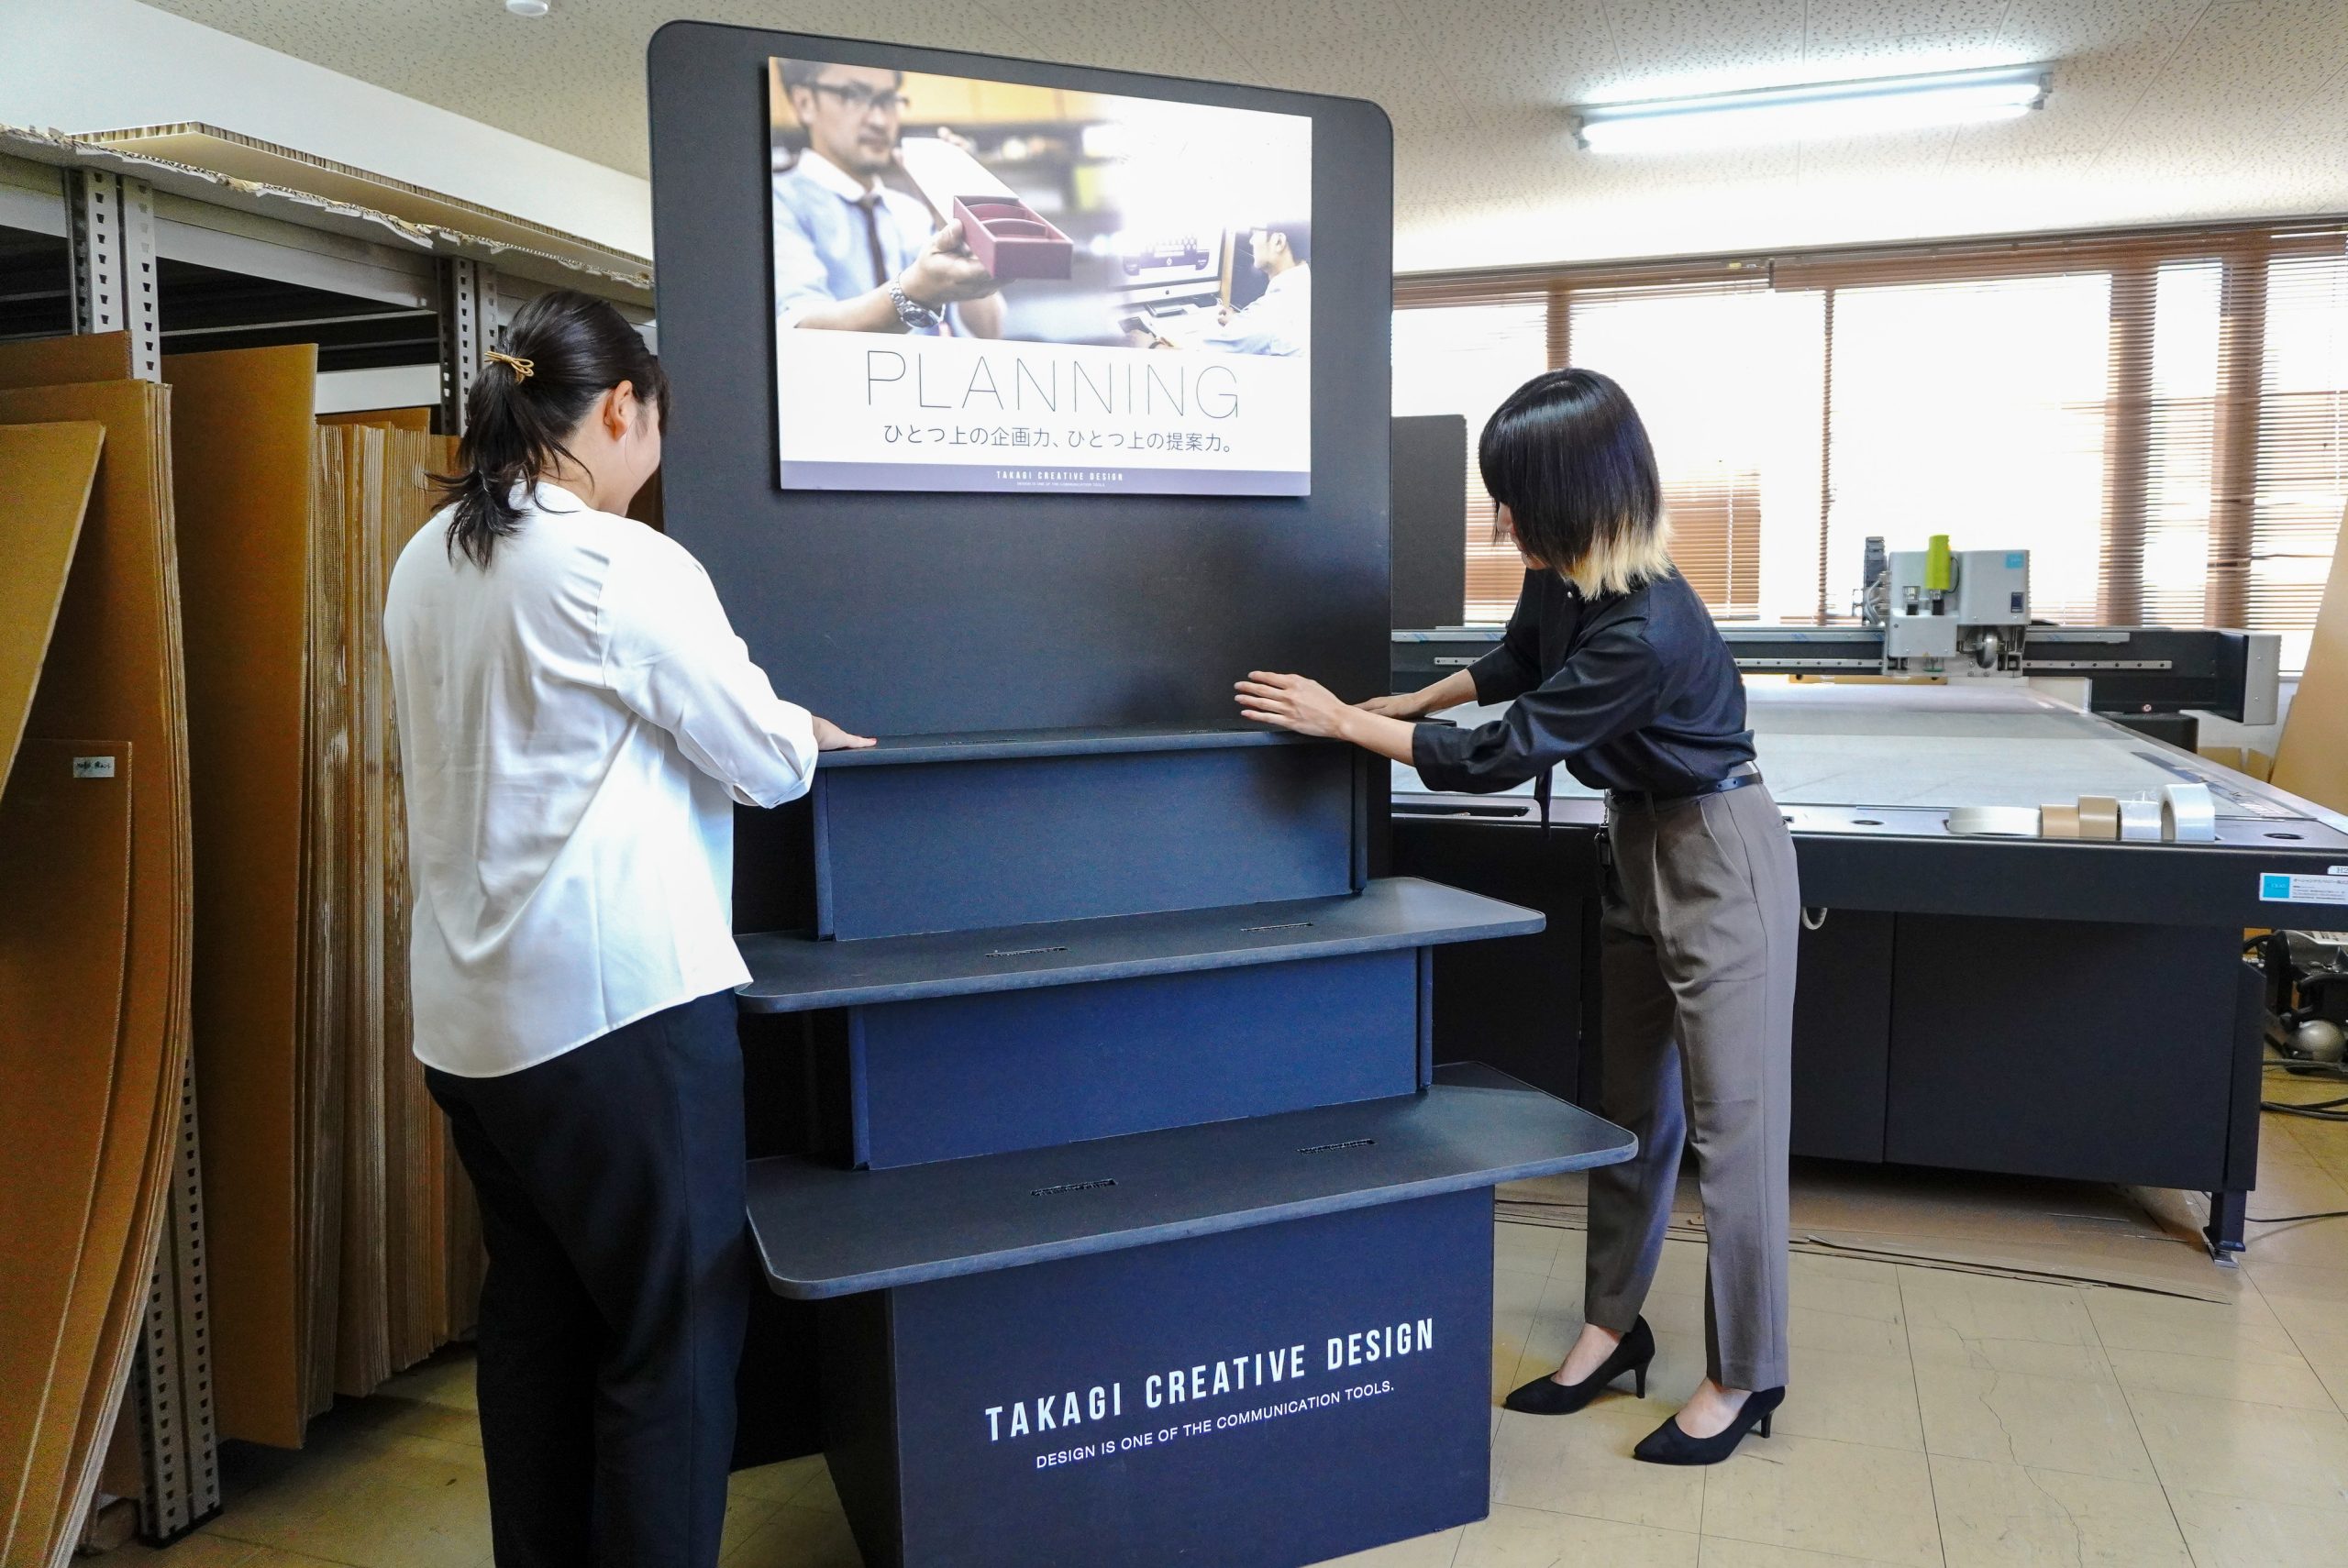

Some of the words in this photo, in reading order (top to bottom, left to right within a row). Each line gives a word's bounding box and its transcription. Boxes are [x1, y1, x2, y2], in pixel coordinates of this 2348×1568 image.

[868, 349, 1238, 419] PLANNING
[884, 424, 1231, 453] ひとつ上の企画力、ひとつ上の提案力。
[996, 470, 1032, 480] TAKAGI
[1037, 471, 1084, 480] CREATIVE
[1090, 472, 1123, 481] DESIGN
[985, 1382, 1121, 1441] TAKAGI
[1146, 1344, 1305, 1408] CREATIVE
[1327, 1318, 1434, 1371] DESIGN
[1036, 1444, 1095, 1469] DESIGN
[1101, 1441, 1116, 1455] IS
[1121, 1431, 1153, 1451] ONE
[1157, 1427, 1179, 1442] OF
[1182, 1419, 1212, 1437] THE
[1216, 1391, 1340, 1430] COMMUNICATION
[1345, 1379, 1394, 1401] TOOLS.
